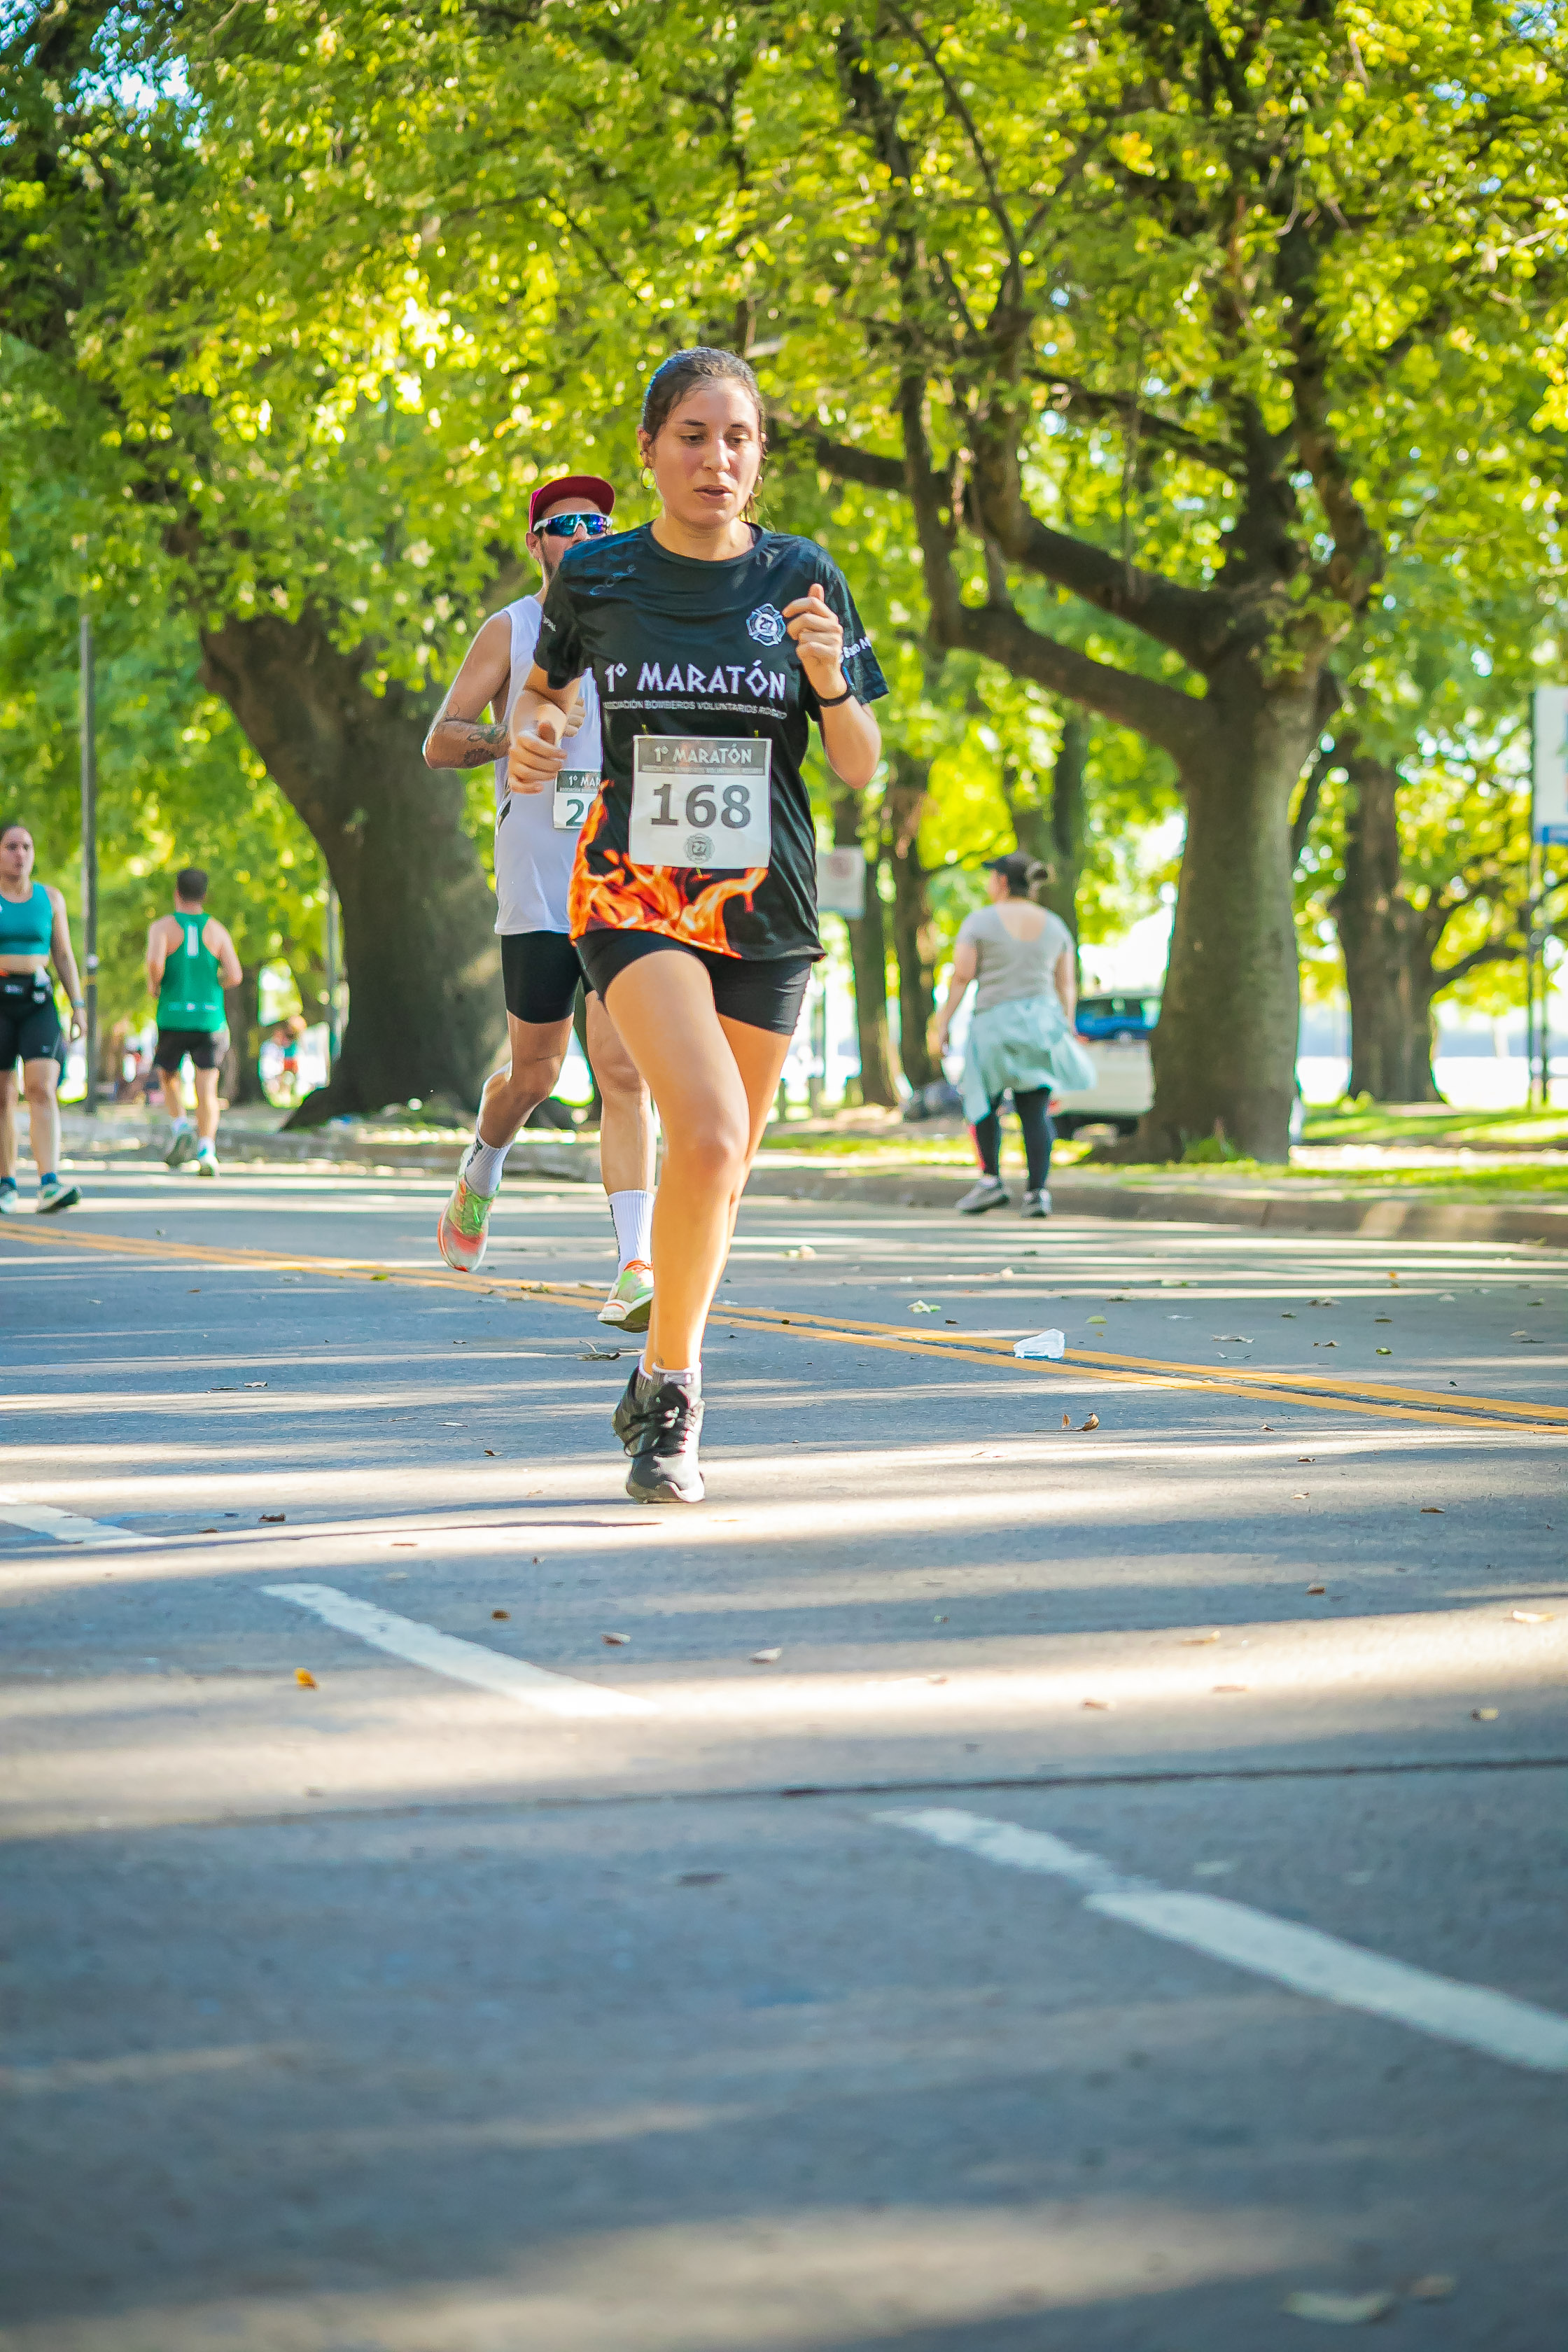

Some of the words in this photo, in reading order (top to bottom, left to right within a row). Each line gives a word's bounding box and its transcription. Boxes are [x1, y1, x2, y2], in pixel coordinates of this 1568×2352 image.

[636, 659, 785, 701] MARATÓN
[672, 743, 752, 764] MARATÓN
[566, 799, 594, 827] 2
[651, 784, 750, 829] 168
